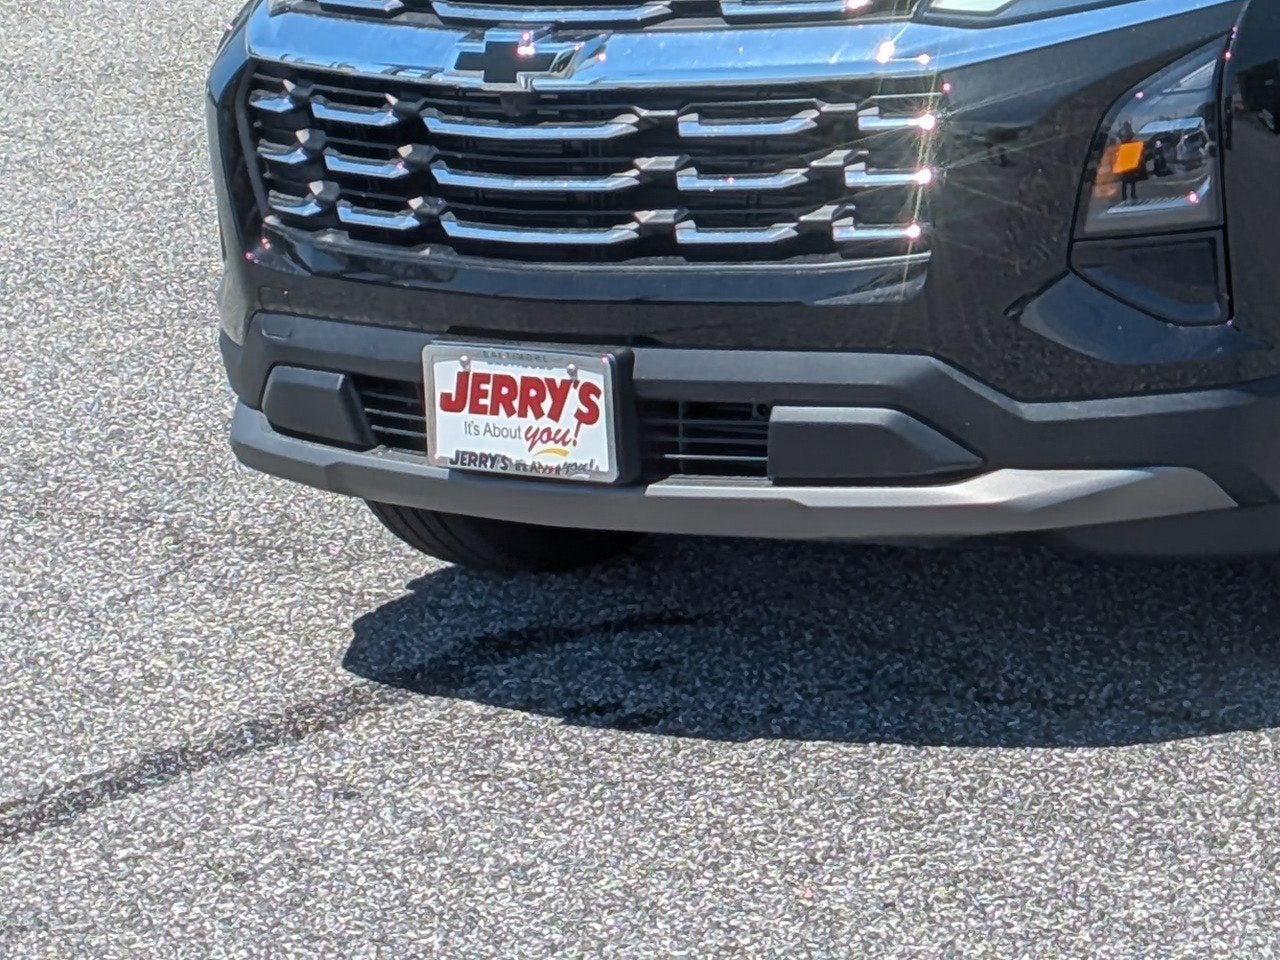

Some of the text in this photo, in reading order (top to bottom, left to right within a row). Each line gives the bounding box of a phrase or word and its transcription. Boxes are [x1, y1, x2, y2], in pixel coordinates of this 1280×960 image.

[439, 371, 602, 426] JERRY'S
[464, 420, 581, 452] It's About you!
[449, 449, 513, 471] JERRY'S
